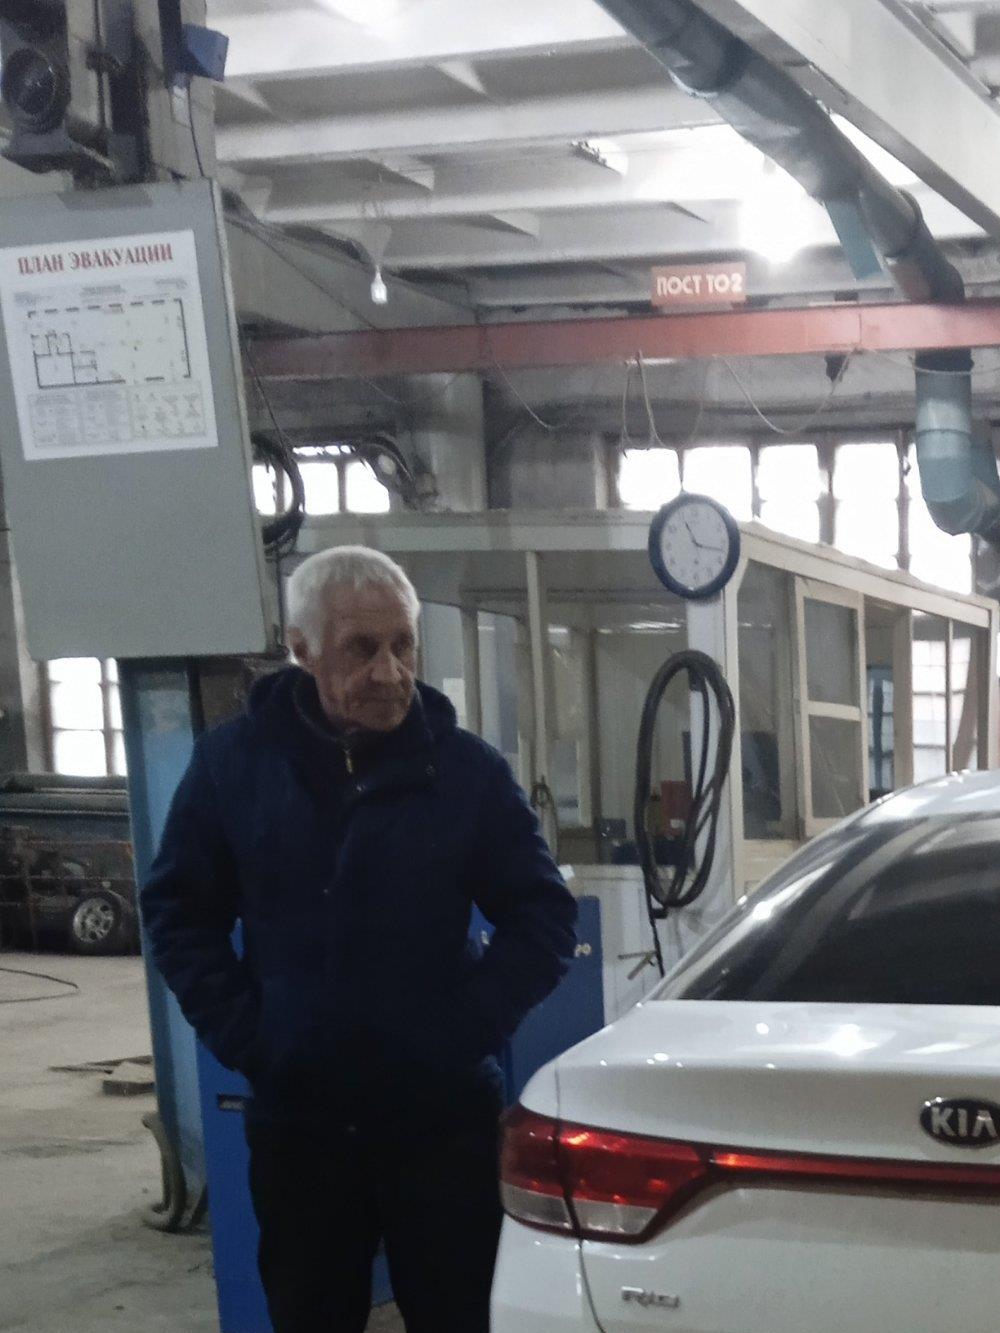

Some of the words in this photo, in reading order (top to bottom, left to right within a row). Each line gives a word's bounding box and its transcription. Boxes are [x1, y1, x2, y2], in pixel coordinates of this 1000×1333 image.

[18, 256, 63, 275] ПЛАН
[70, 244, 173, 270] ЭВАКУАЦИИ
[657, 275, 701, 296] ПОСТ
[930, 1106, 998, 1138] KIA
